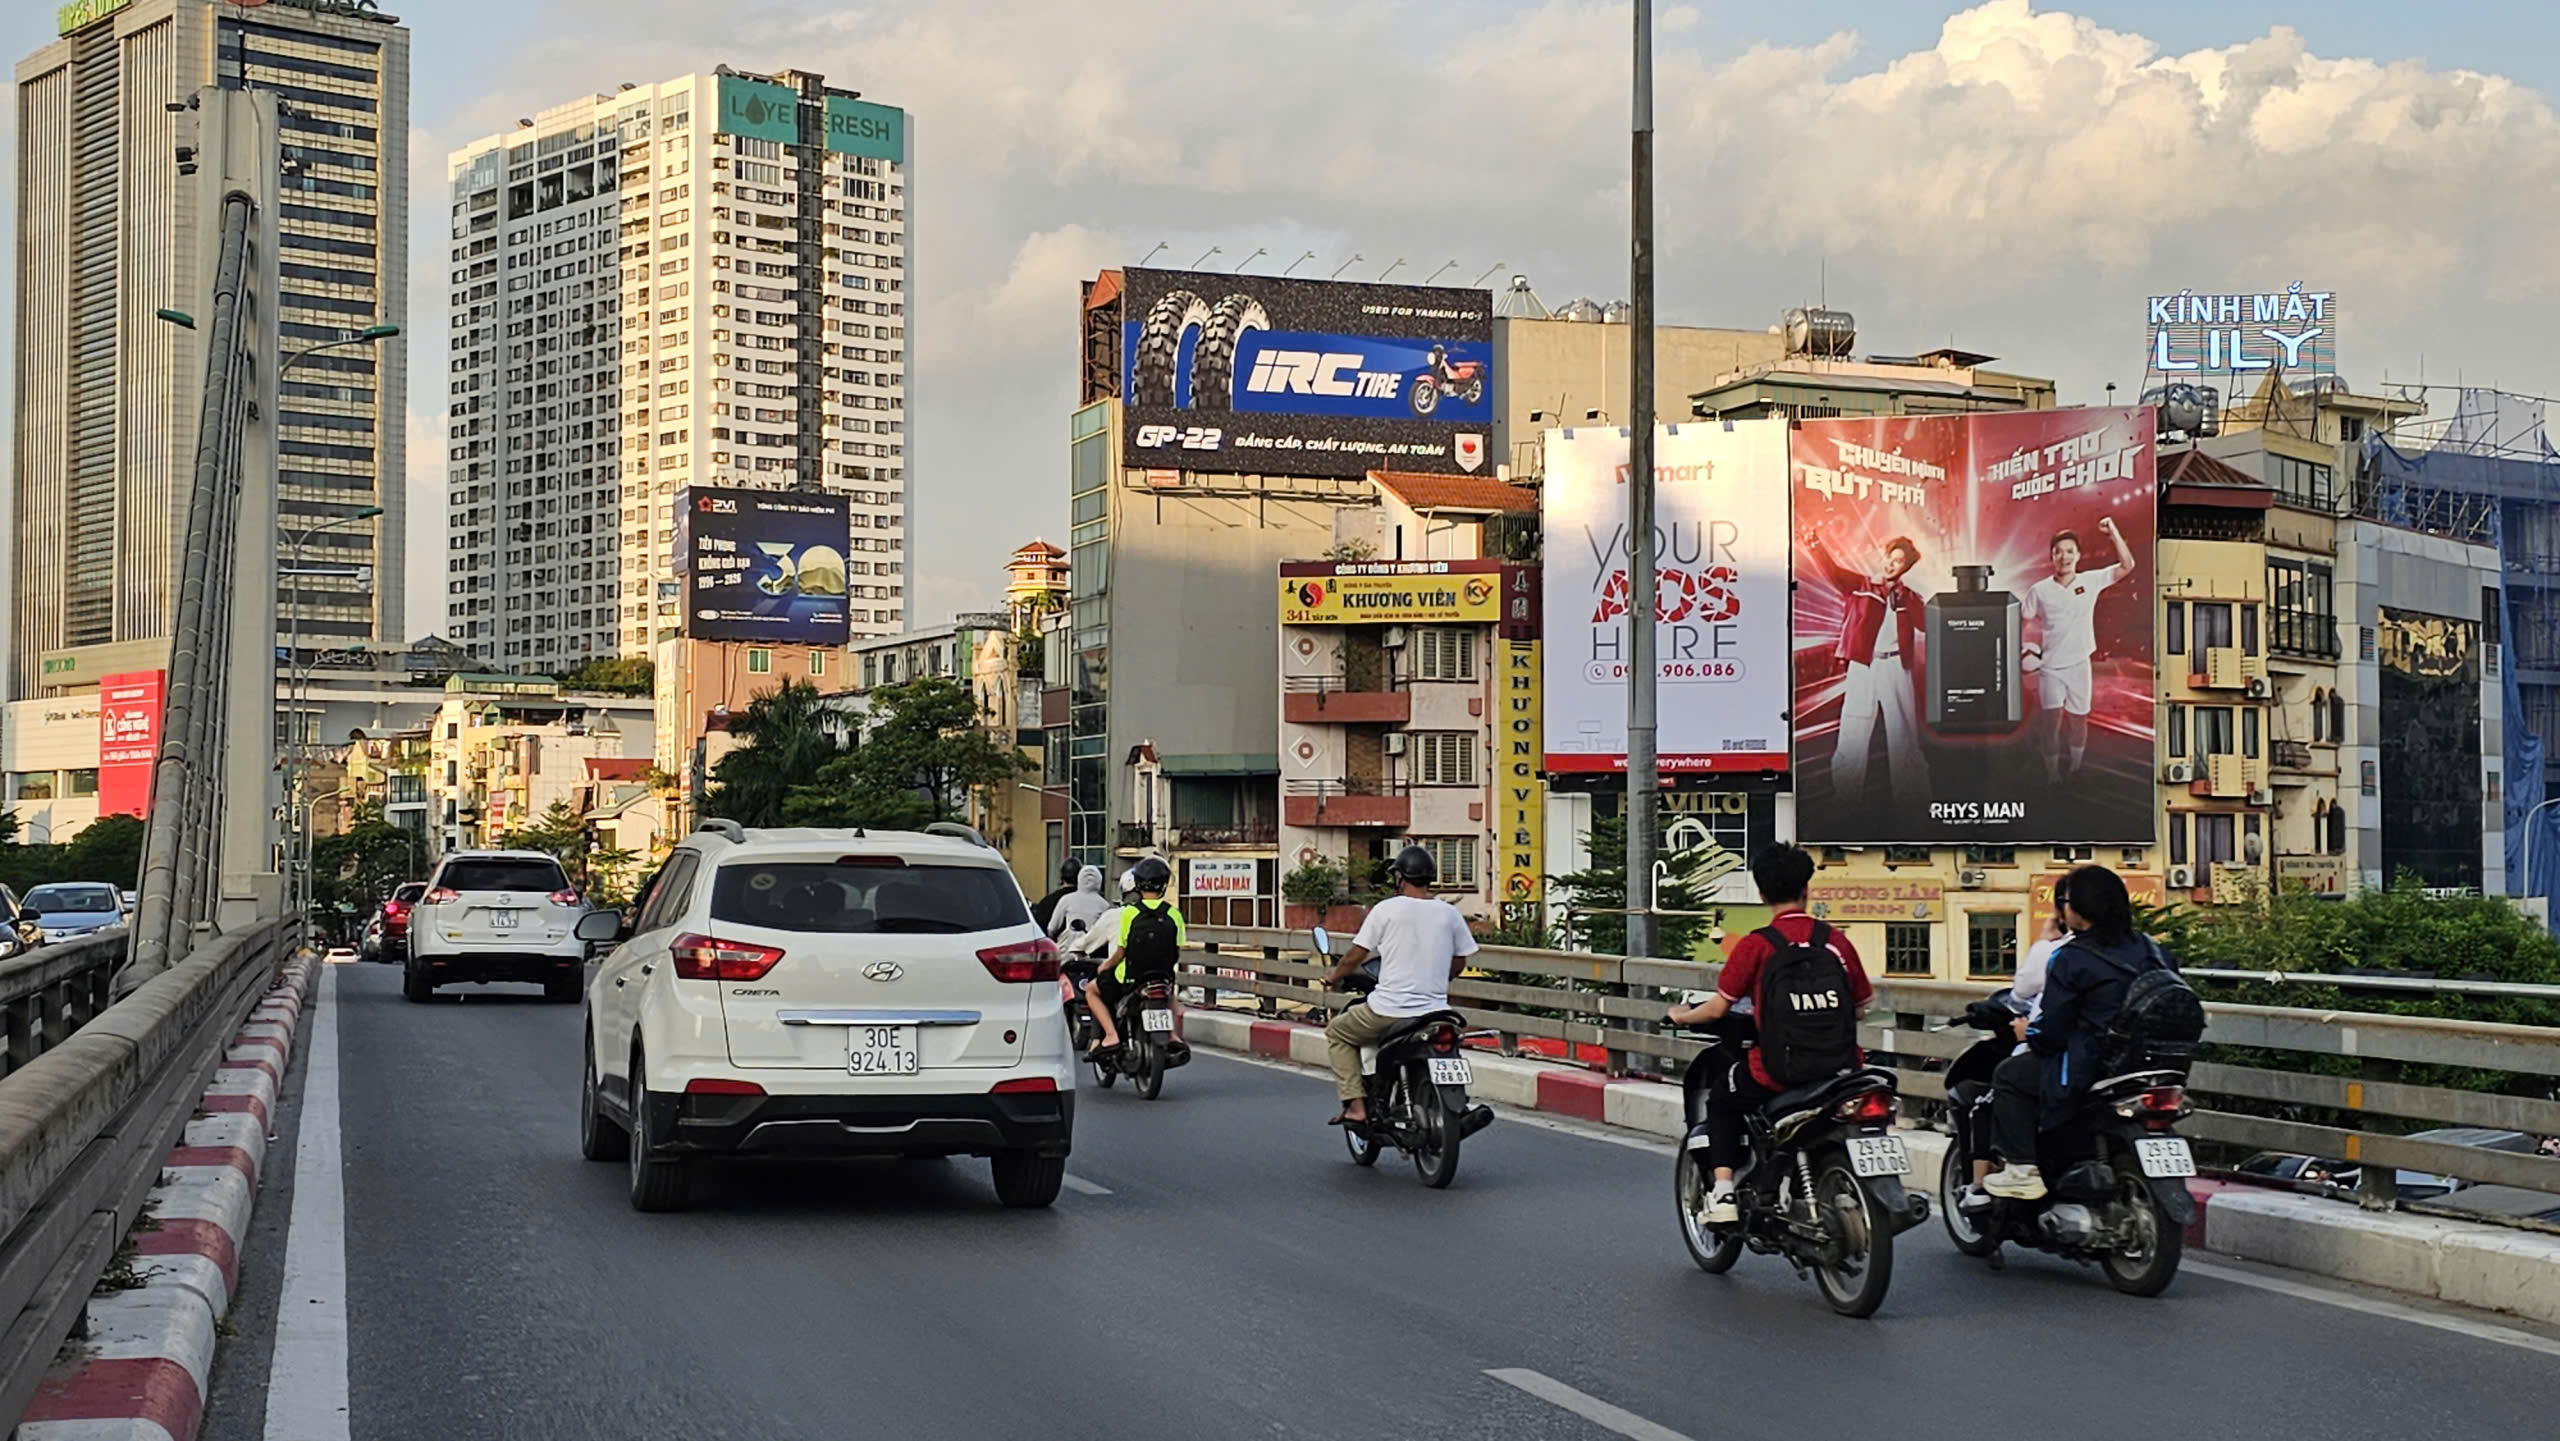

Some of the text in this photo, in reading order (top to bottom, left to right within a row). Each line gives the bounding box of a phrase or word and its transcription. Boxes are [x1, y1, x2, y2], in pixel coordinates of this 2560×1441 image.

[825, 110, 890, 142] RESH
[1361, 305, 1389, 315] USED
[1392, 306, 1413, 316] FOR
[1415, 308, 1459, 319] YAMAHA
[2150, 280, 2331, 324] KÍNH MẮT
[2156, 328, 2324, 370] LILY
[1355, 372, 1402, 399] TIRE
[1136, 425, 1222, 451] GP-22
[1388, 443, 1408, 455] AN
[1410, 442, 1445, 456] TOÀN
[1343, 587, 1457, 608] KHƯƠNG VIÊN
[1287, 609, 1311, 621] 341
[1612, 663, 1735, 680] 09.906.086
[1929, 802, 2025, 819] RHYS MAN
[1512, 787, 1532, 868] VIÊN
[732, 988, 781, 997] CRETA
[1789, 989, 1839, 1011] VANS
[865, 1028, 901, 1049] 30E
[850, 1050, 916, 1072] 924.13
